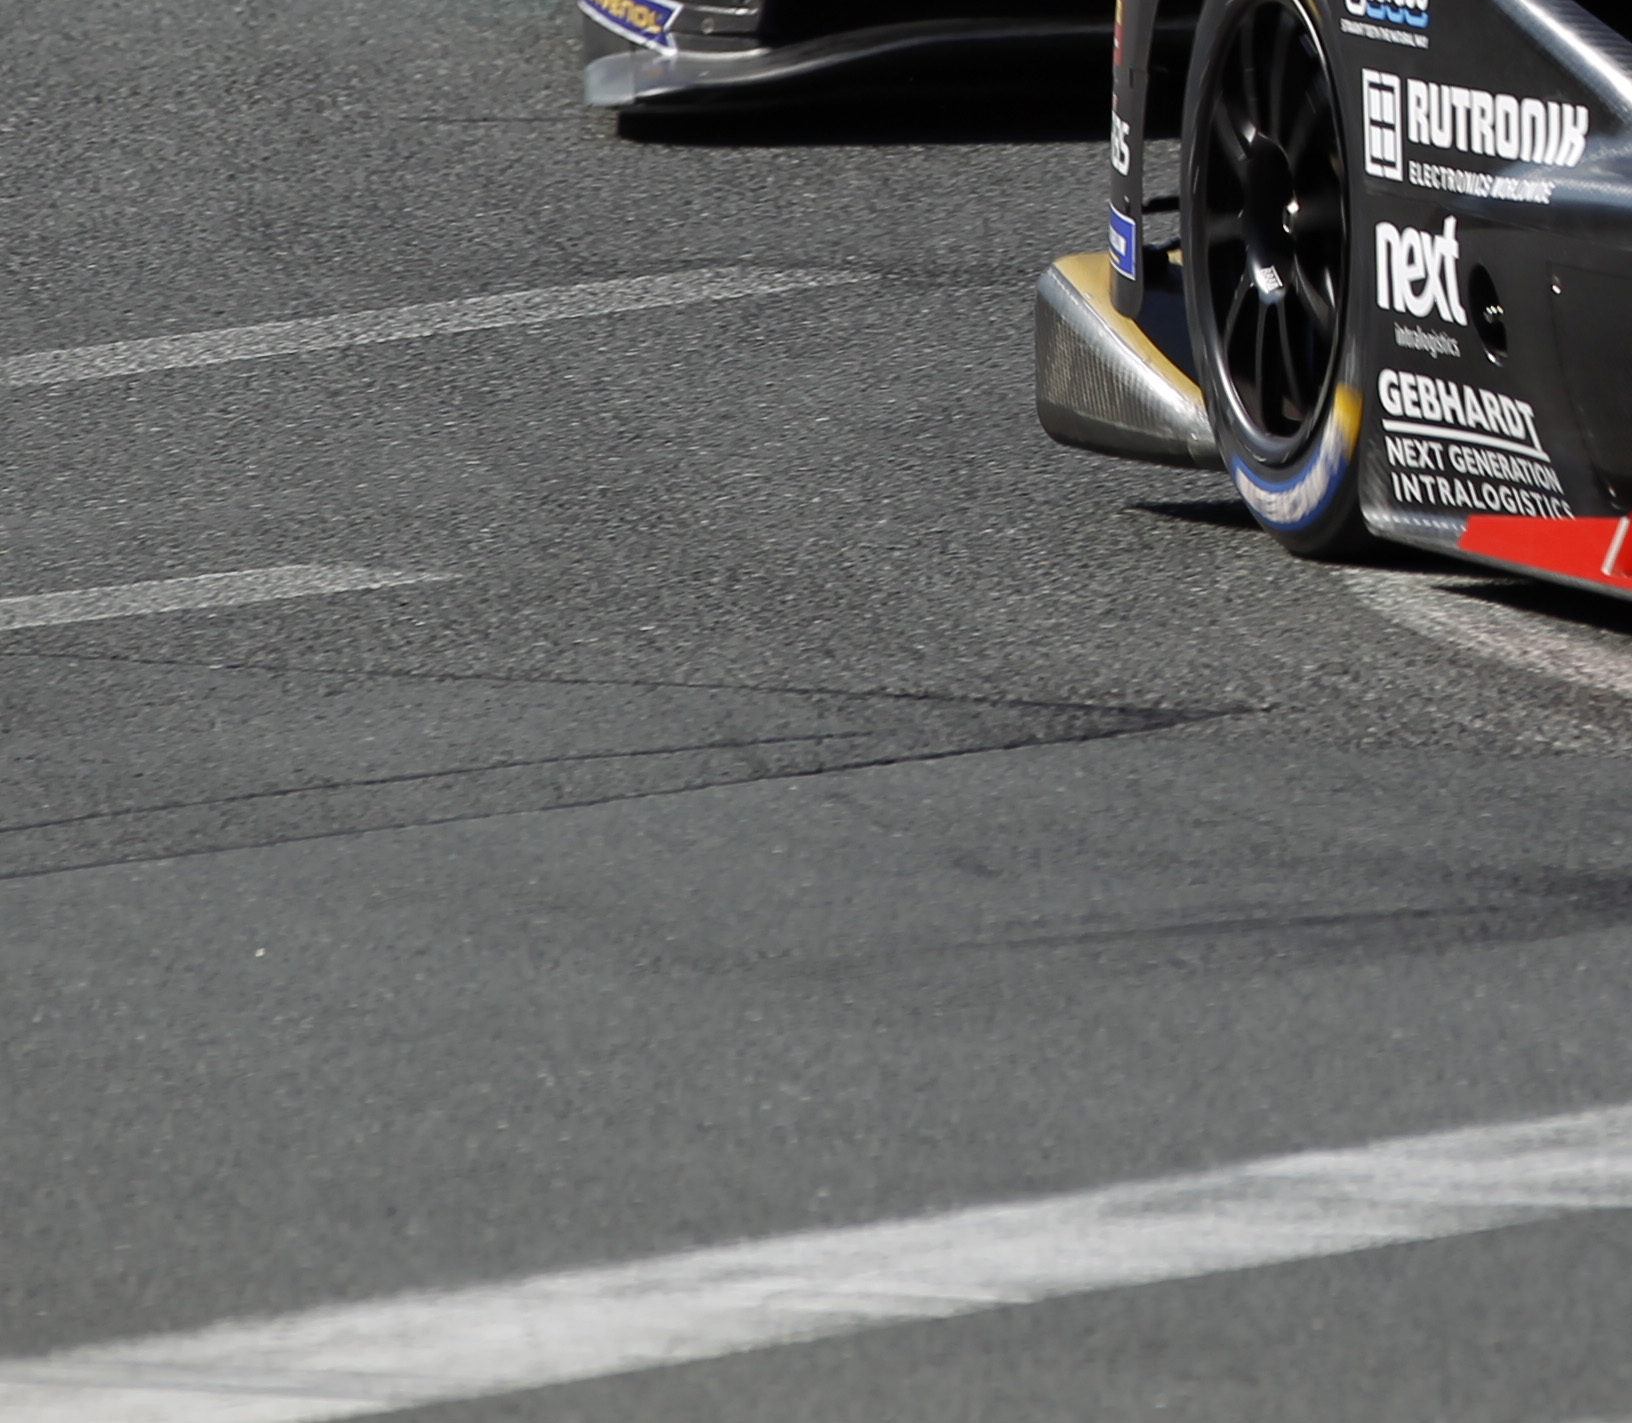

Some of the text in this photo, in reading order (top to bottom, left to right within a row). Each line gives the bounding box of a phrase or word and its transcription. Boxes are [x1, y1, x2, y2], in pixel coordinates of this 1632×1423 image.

[1407, 78, 1589, 168] RUTRONIK
[1409, 161, 1493, 198] ELECTRONICS
[1375, 214, 1467, 327] next
[1394, 323, 1461, 359] intralogistics
[1379, 367, 1541, 454] GEBHARDT
[1385, 434, 1566, 496] NEXT GENERATION
[1391, 472, 1576, 521] INTRALOGISTICS
